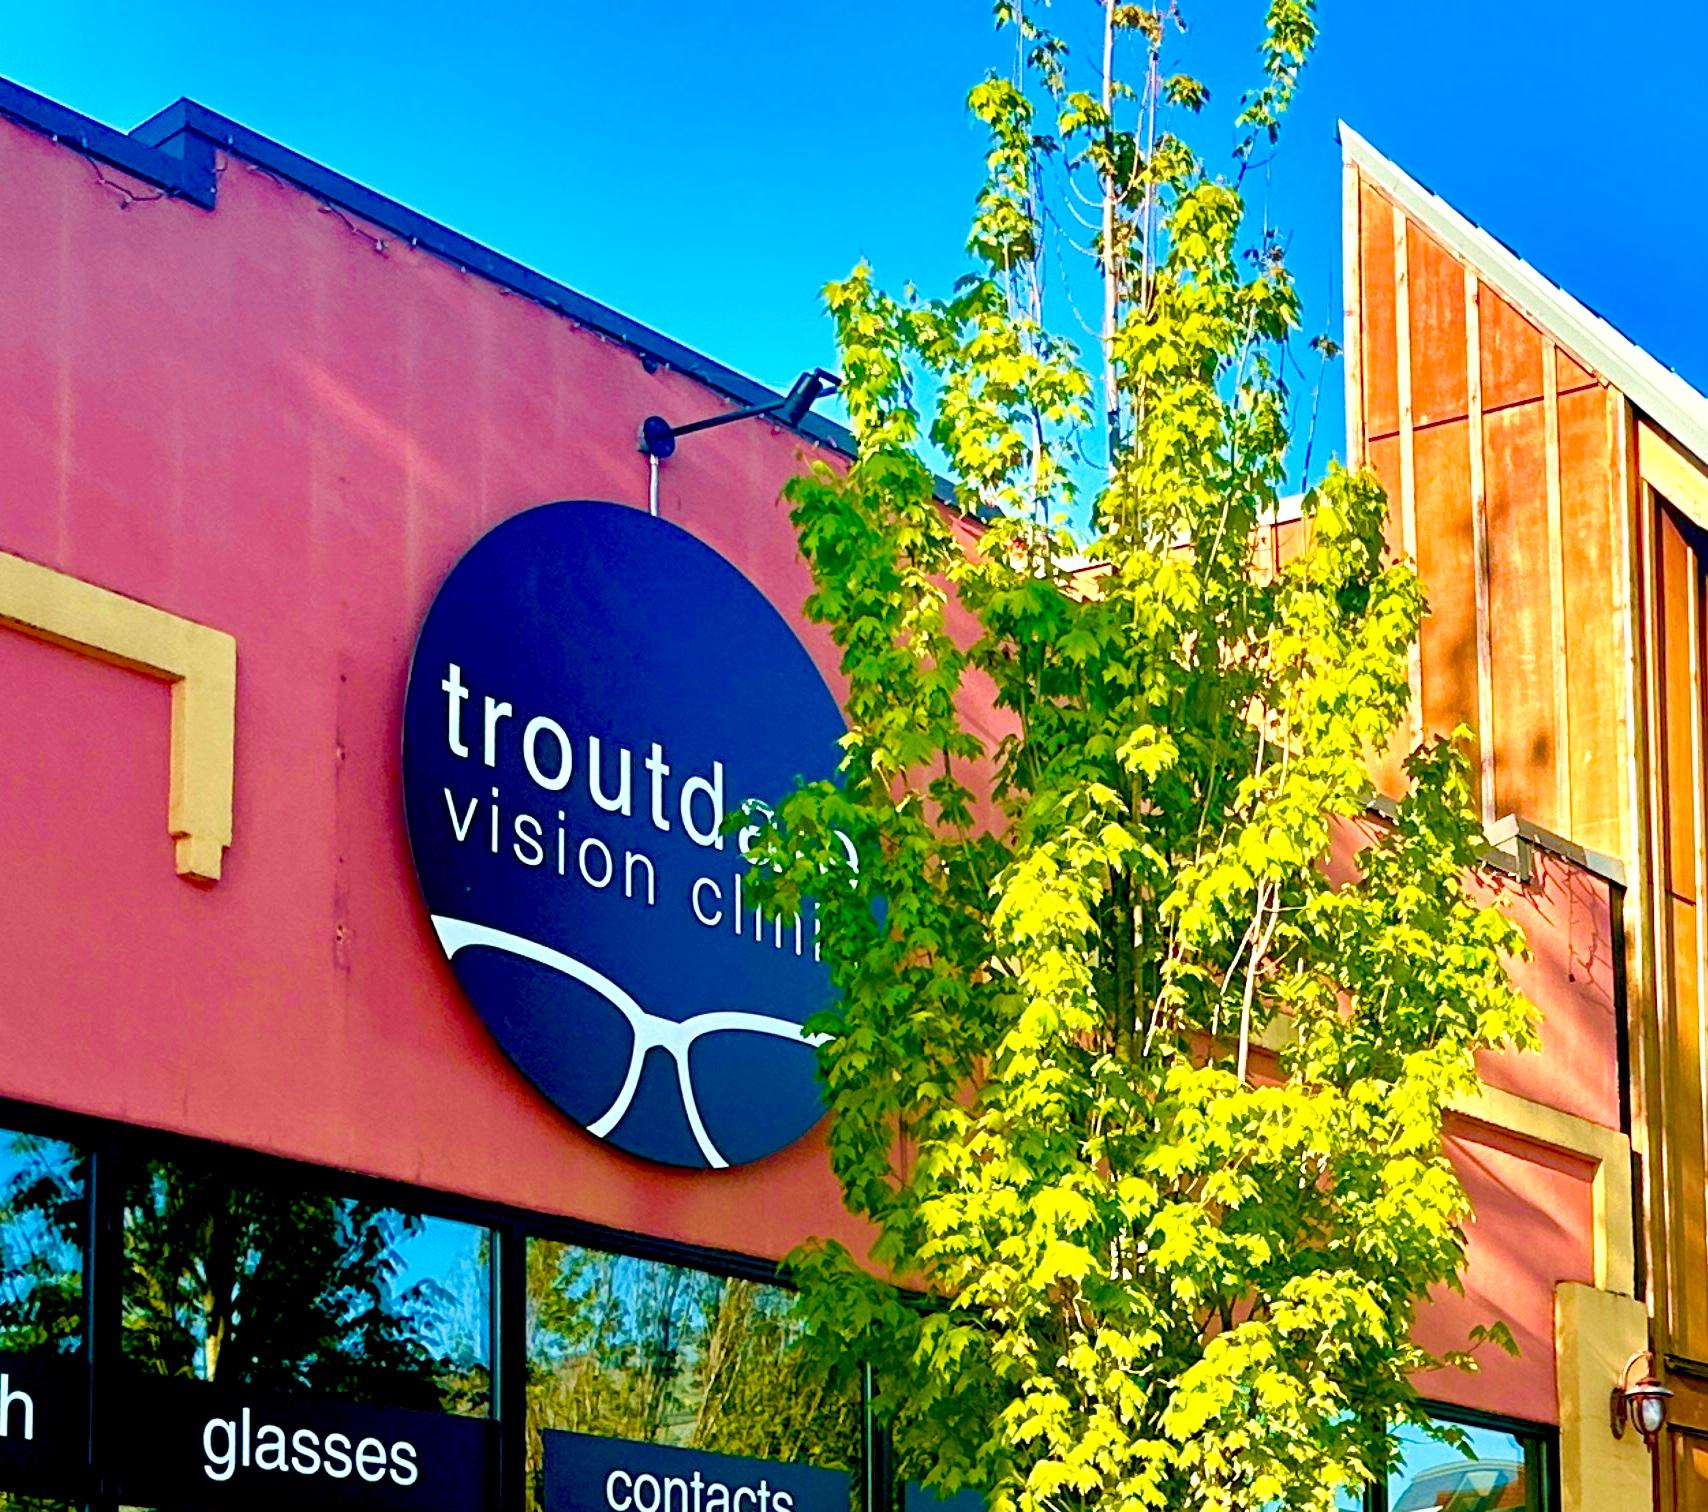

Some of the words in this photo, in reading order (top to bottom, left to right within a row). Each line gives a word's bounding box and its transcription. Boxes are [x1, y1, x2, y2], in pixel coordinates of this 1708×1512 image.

[441, 662, 860, 890] troutda
[443, 787, 657, 906] vision
[691, 873, 822, 963] clini
[203, 1407, 419, 1486] glasses
